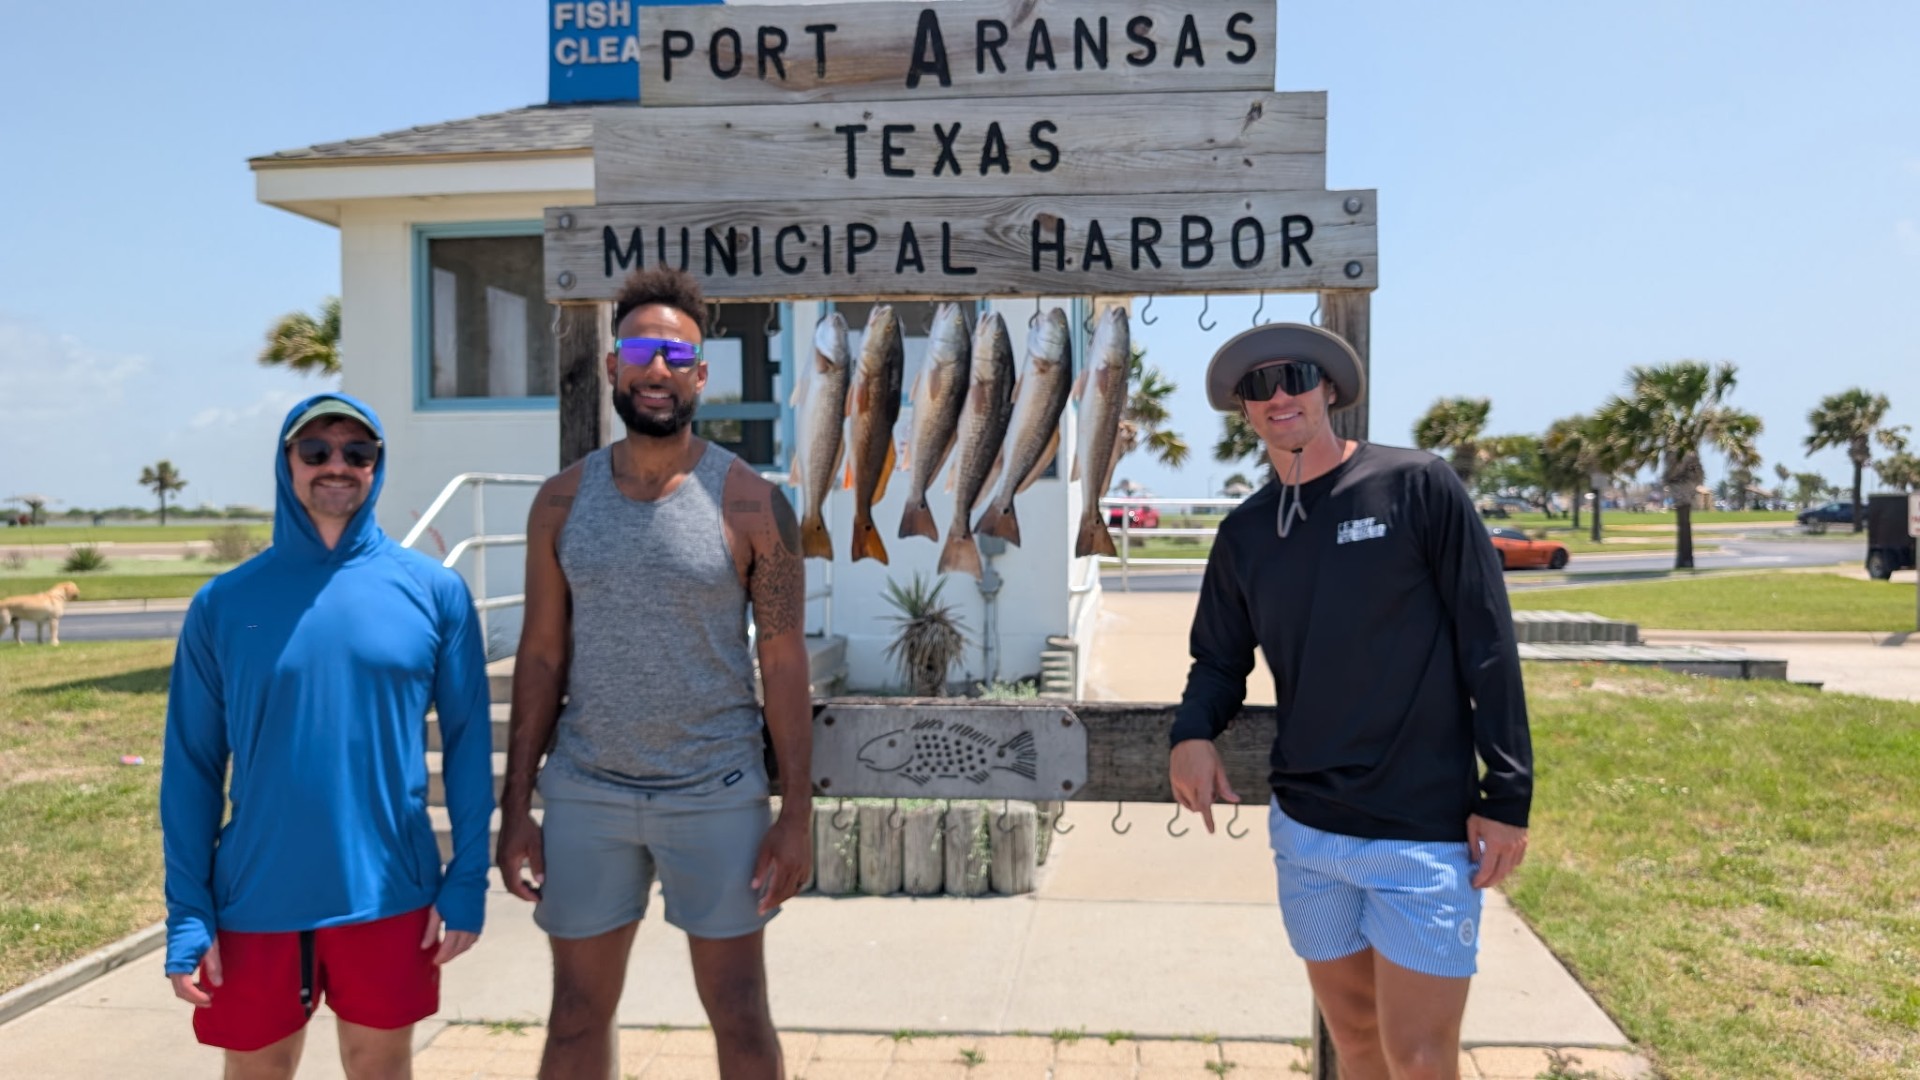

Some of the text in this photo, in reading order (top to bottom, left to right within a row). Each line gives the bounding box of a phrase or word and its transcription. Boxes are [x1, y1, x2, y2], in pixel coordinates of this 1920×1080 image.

[554, 0, 631, 30] FISH
[662, 8, 1257, 89] PORT ARANSAS
[835, 119, 1060, 180] TEXAS
[603, 214, 1315, 277] MUNICIPAL HARBOR
